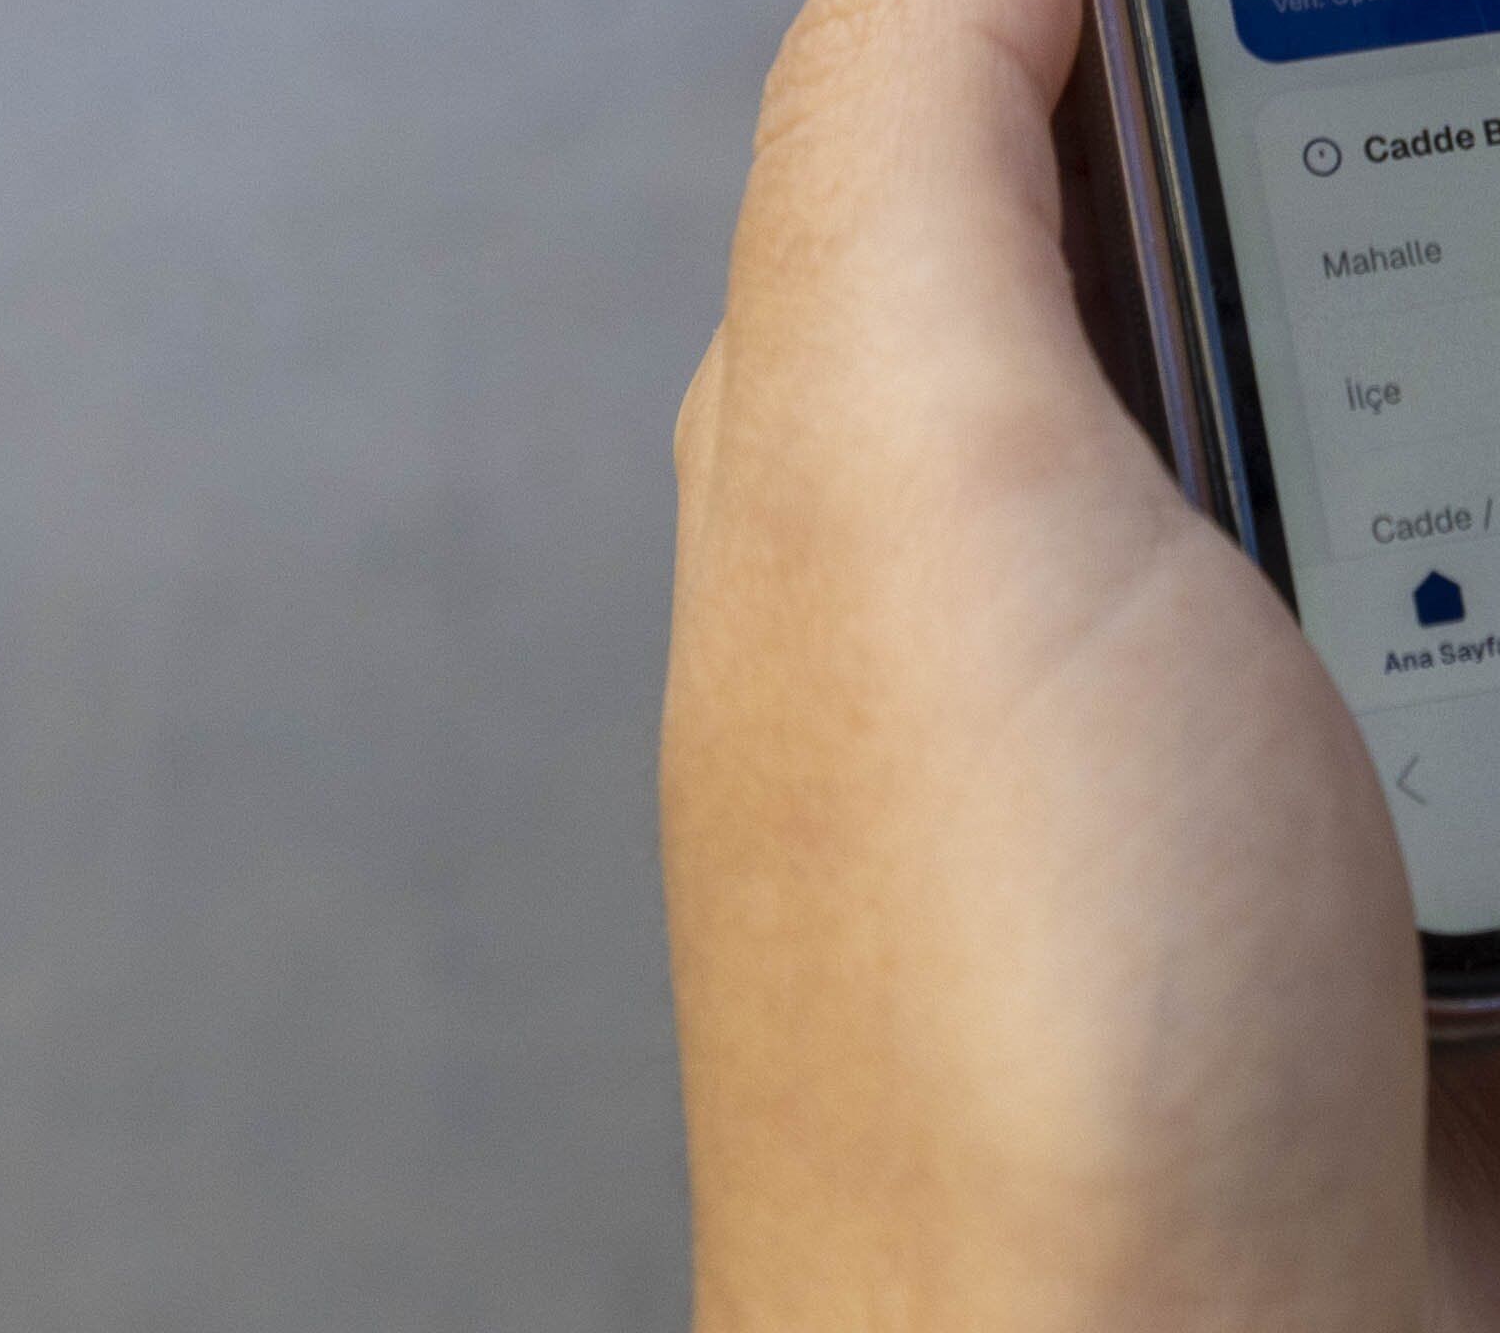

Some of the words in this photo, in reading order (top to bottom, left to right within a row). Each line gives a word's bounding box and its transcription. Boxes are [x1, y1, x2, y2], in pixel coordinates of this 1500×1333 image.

[1363, 126, 1476, 164] Cadde
[1322, 240, 1443, 279] Mahalle
[1346, 378, 1401, 414] İlçe
[1371, 502, 1473, 545] Cadde
[1384, 650, 1434, 675] Ana
